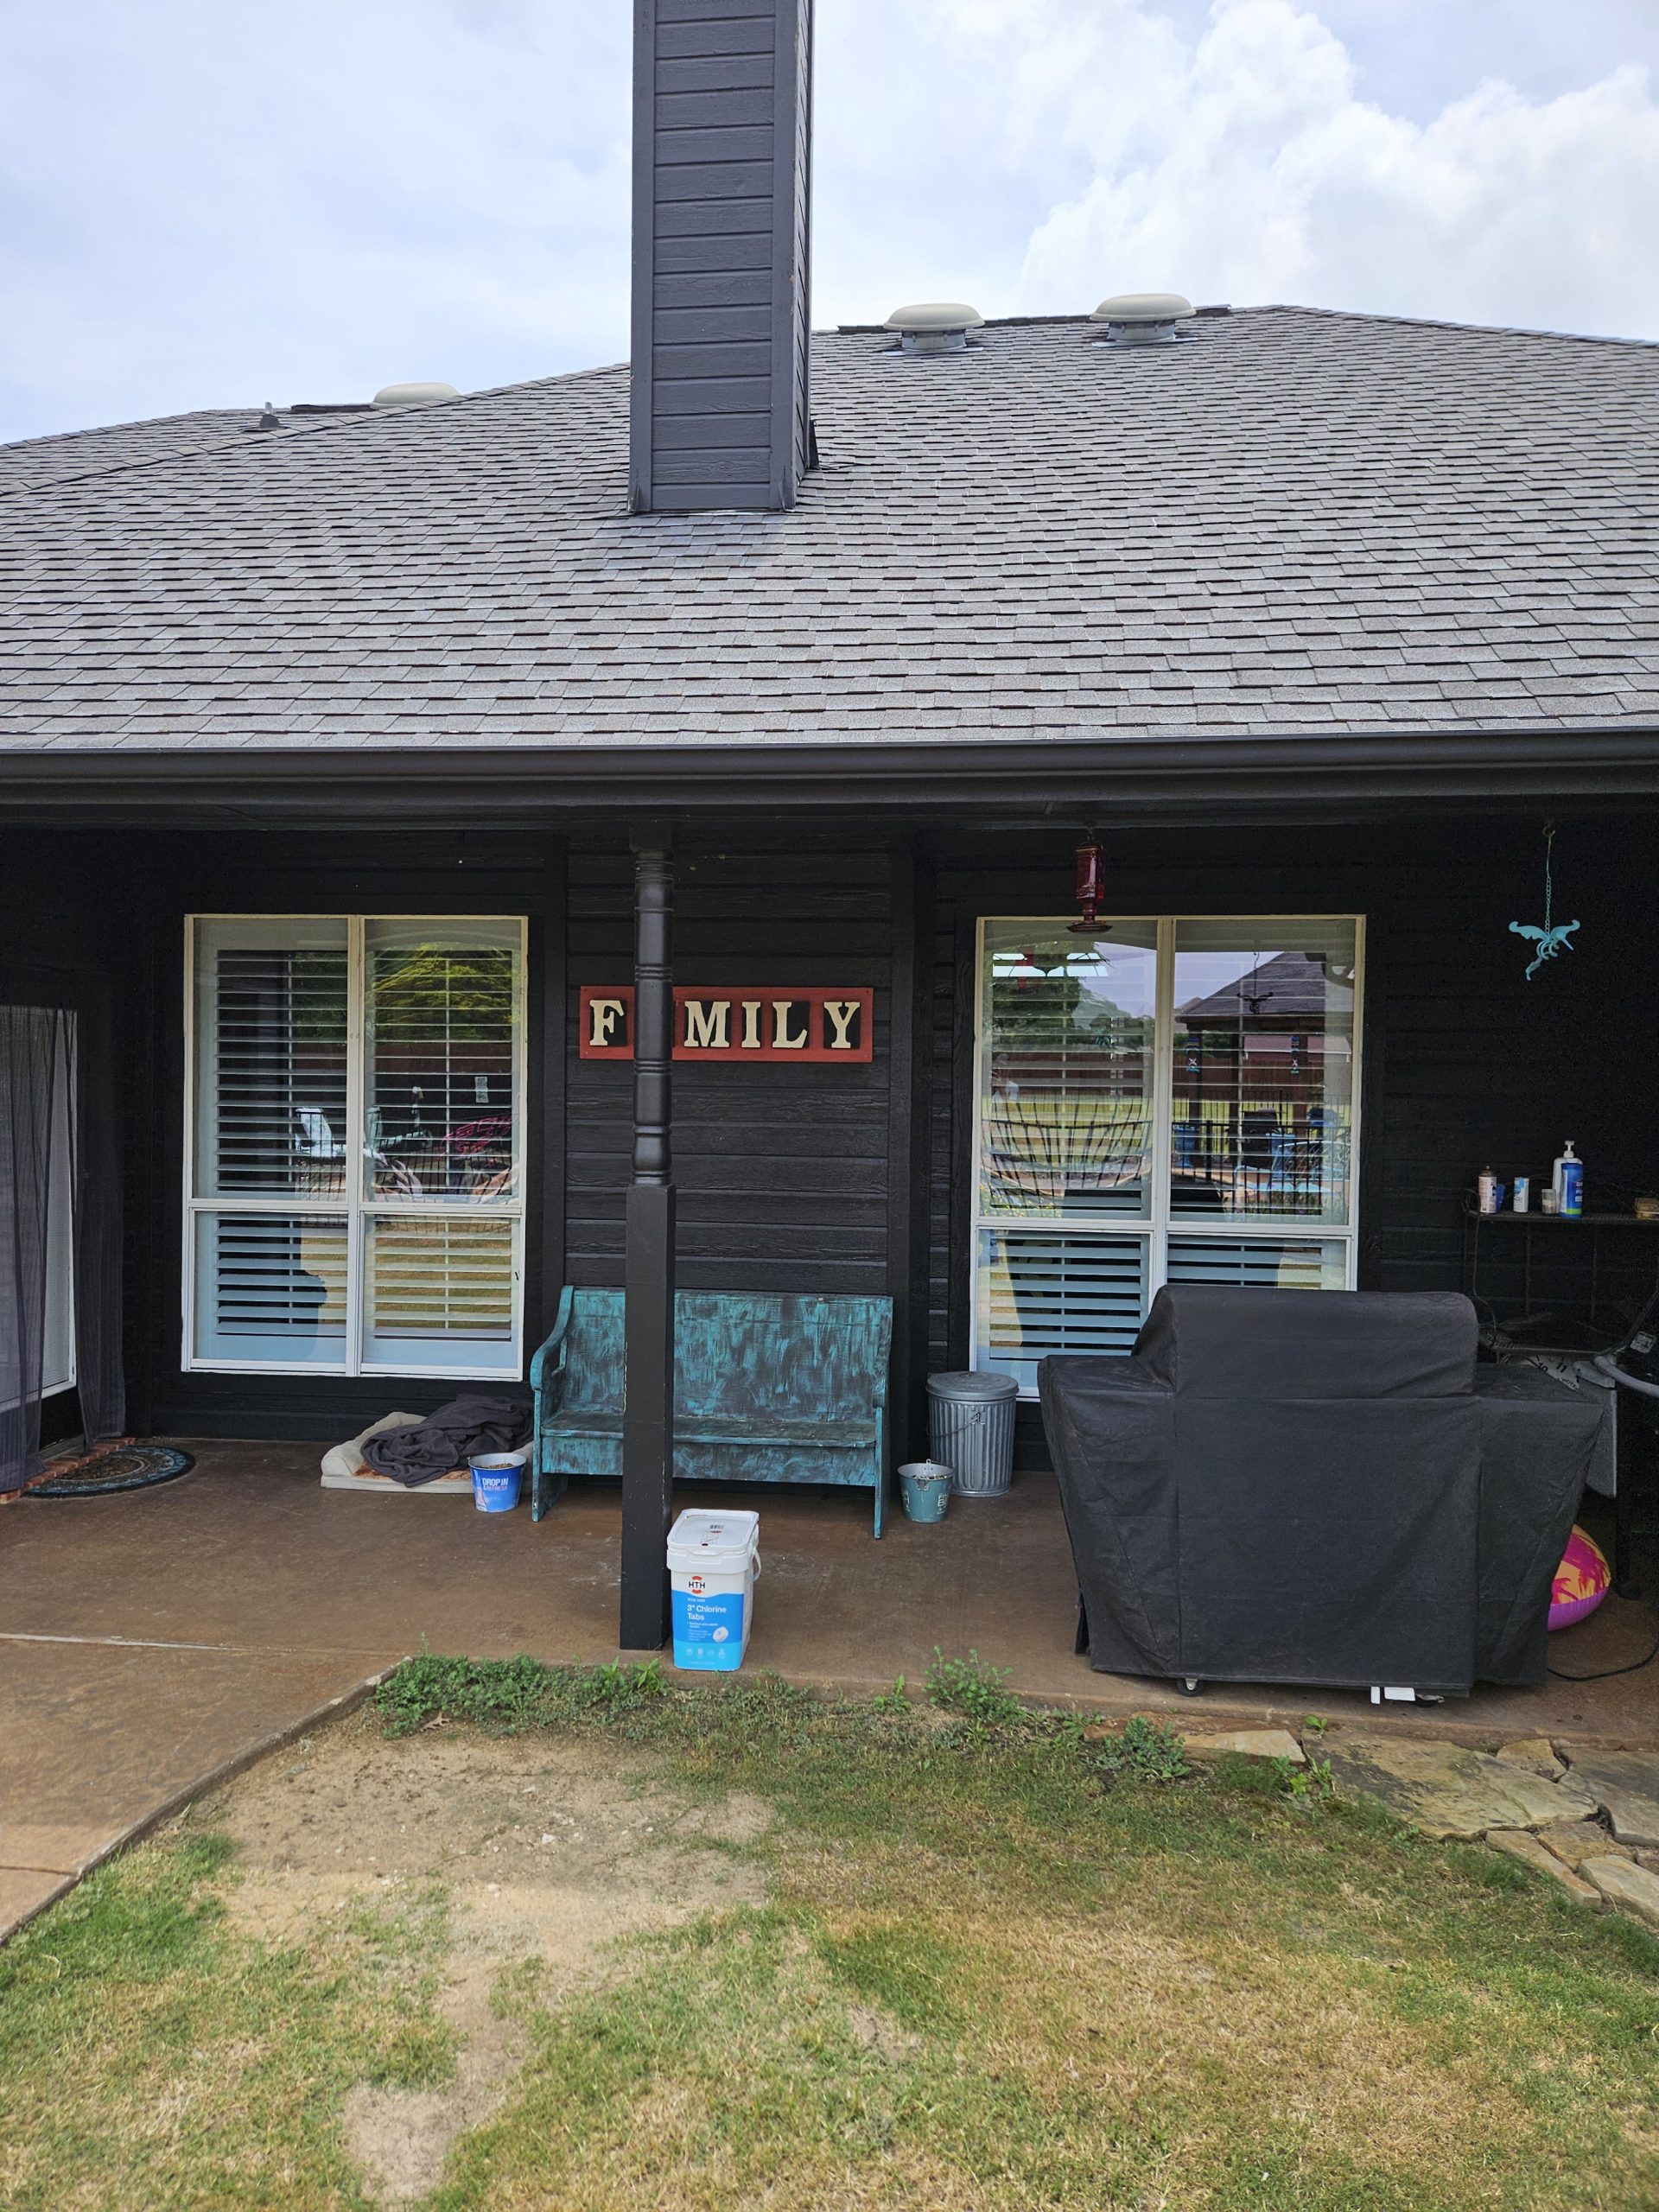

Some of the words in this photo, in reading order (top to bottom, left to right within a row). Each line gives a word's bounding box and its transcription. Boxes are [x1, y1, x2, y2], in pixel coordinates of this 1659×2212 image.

[589, 1000, 860, 1048] FMILY
[482, 1478, 501, 1486] DROP
[501, 1478, 509, 1486] IN
[687, 1612, 705, 1621] Tabs
